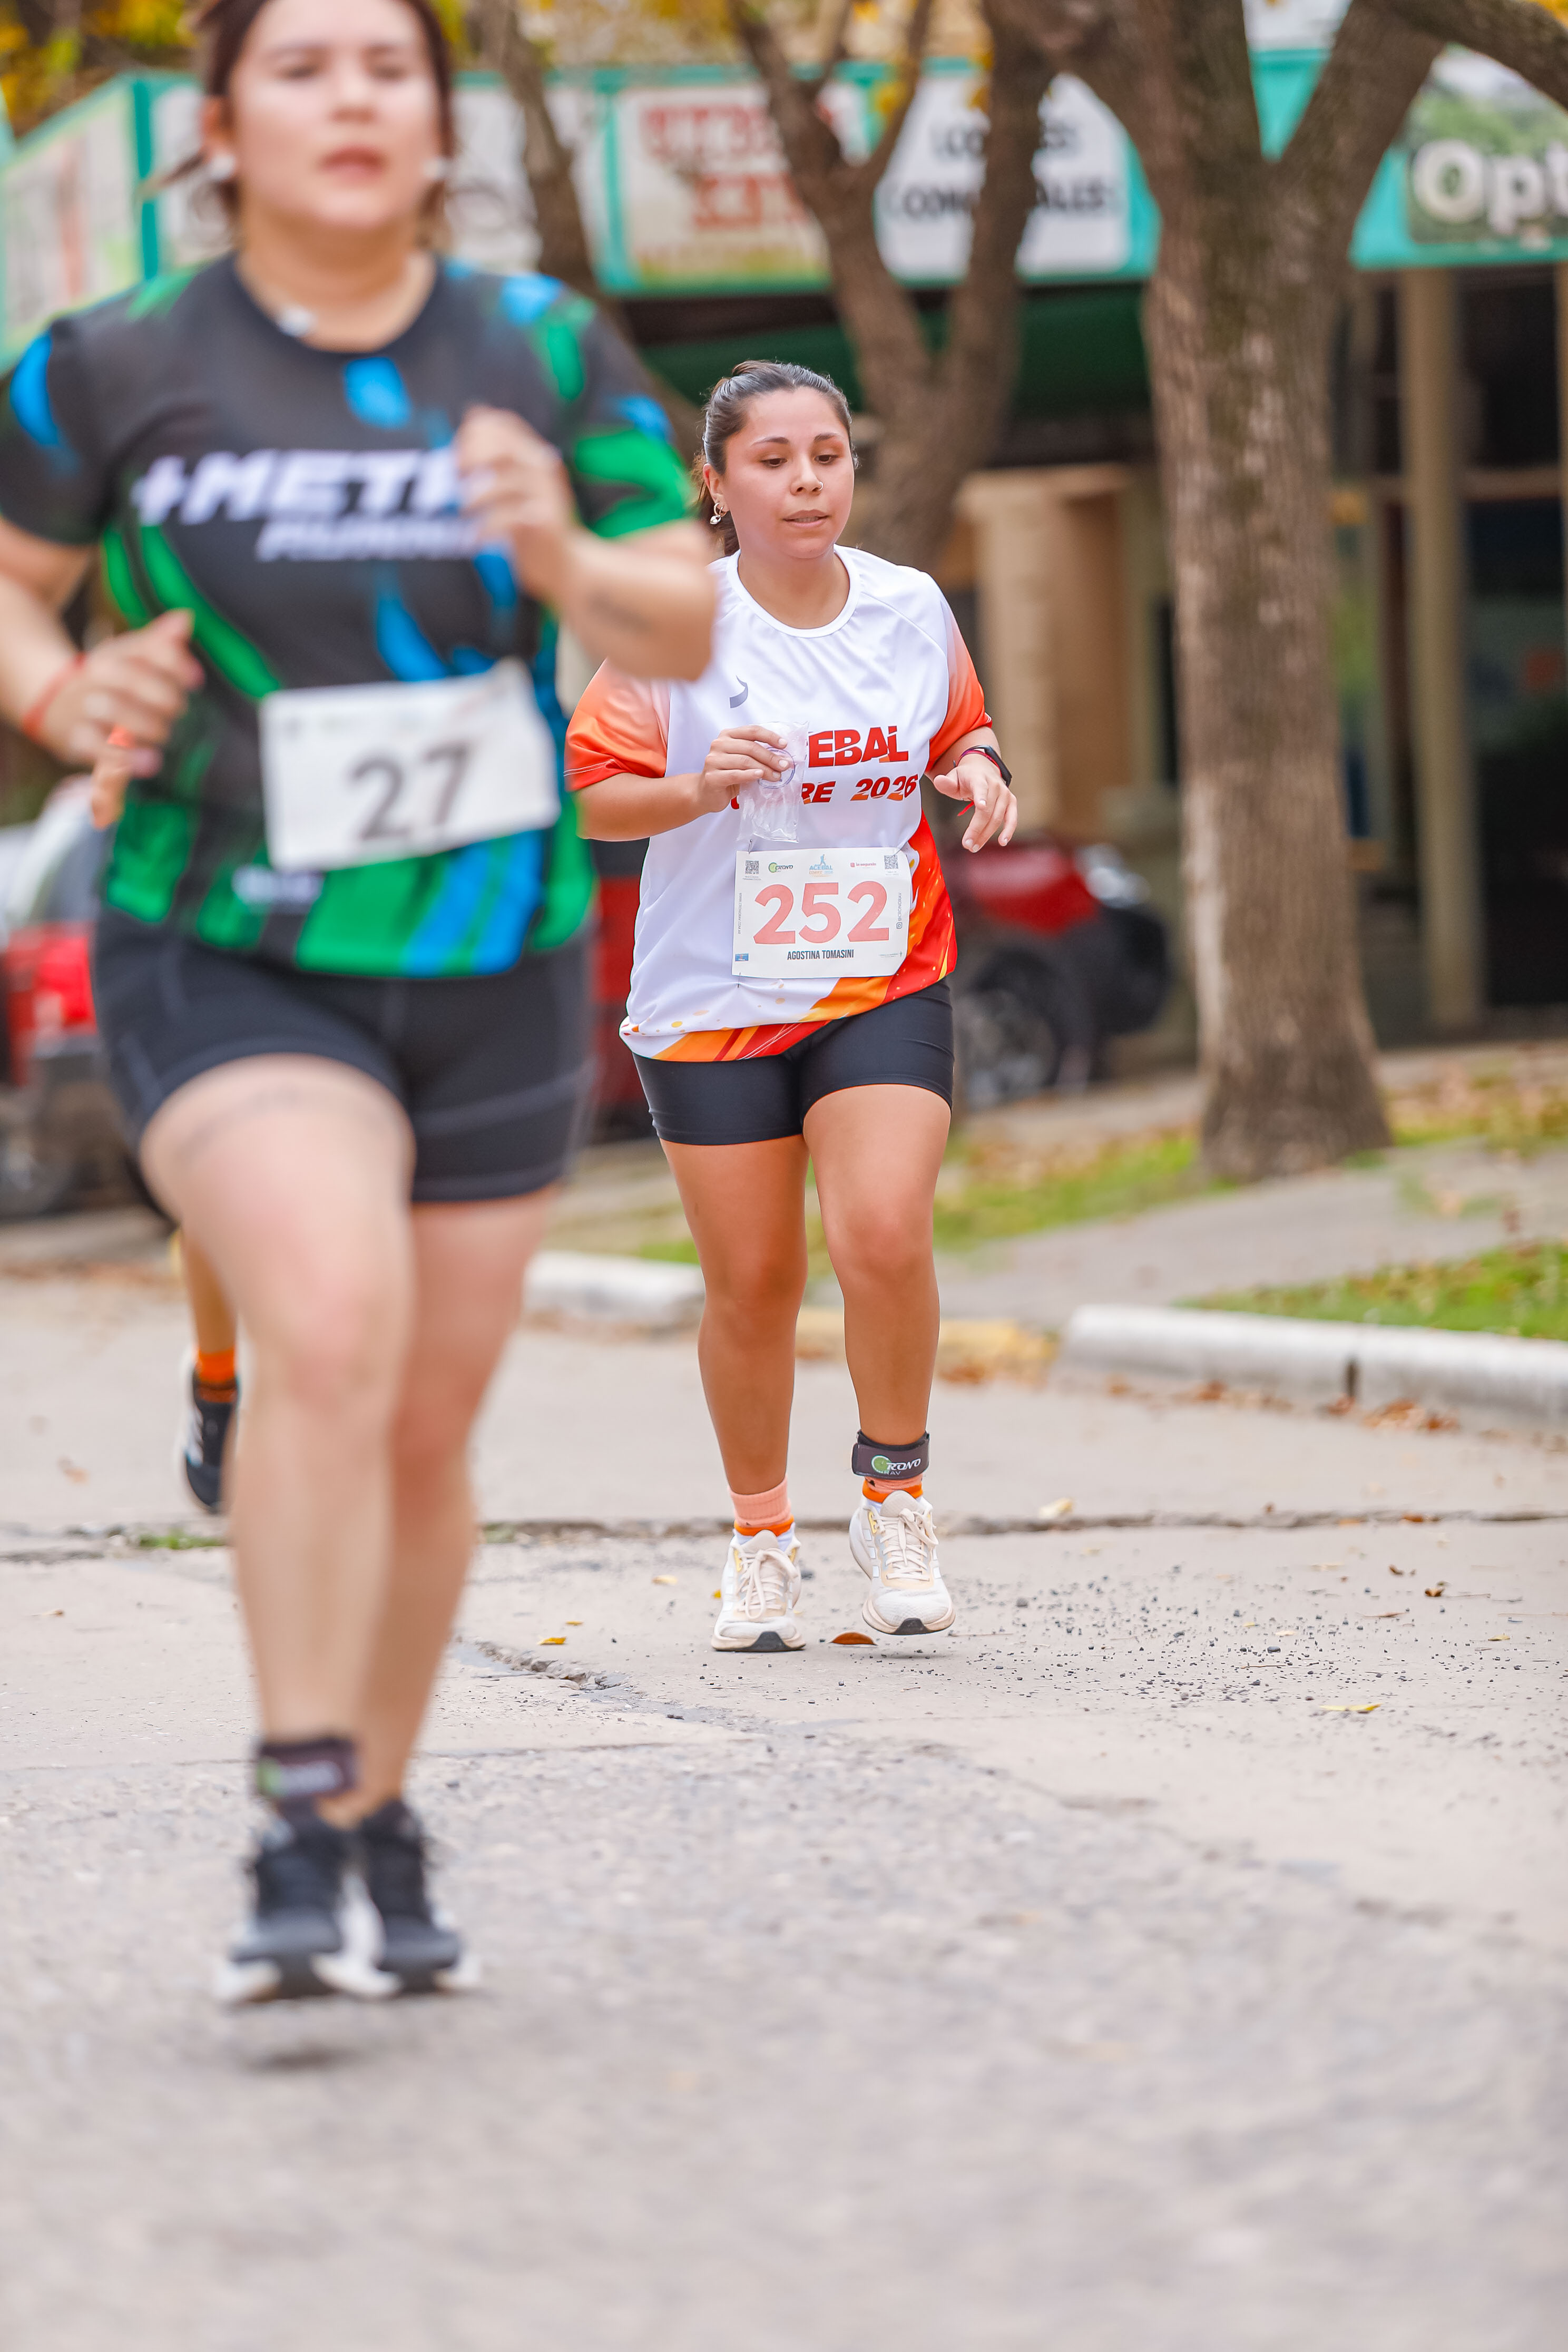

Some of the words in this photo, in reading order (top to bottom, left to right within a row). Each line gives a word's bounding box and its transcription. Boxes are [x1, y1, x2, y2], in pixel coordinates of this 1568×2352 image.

[806, 726, 909, 768] EBAL
[347, 743, 477, 843] 27
[849, 773, 918, 801] 2026
[753, 880, 889, 945] 252
[787, 950, 820, 960] AGOSTINA
[822, 949, 854, 959] TOMASINI
